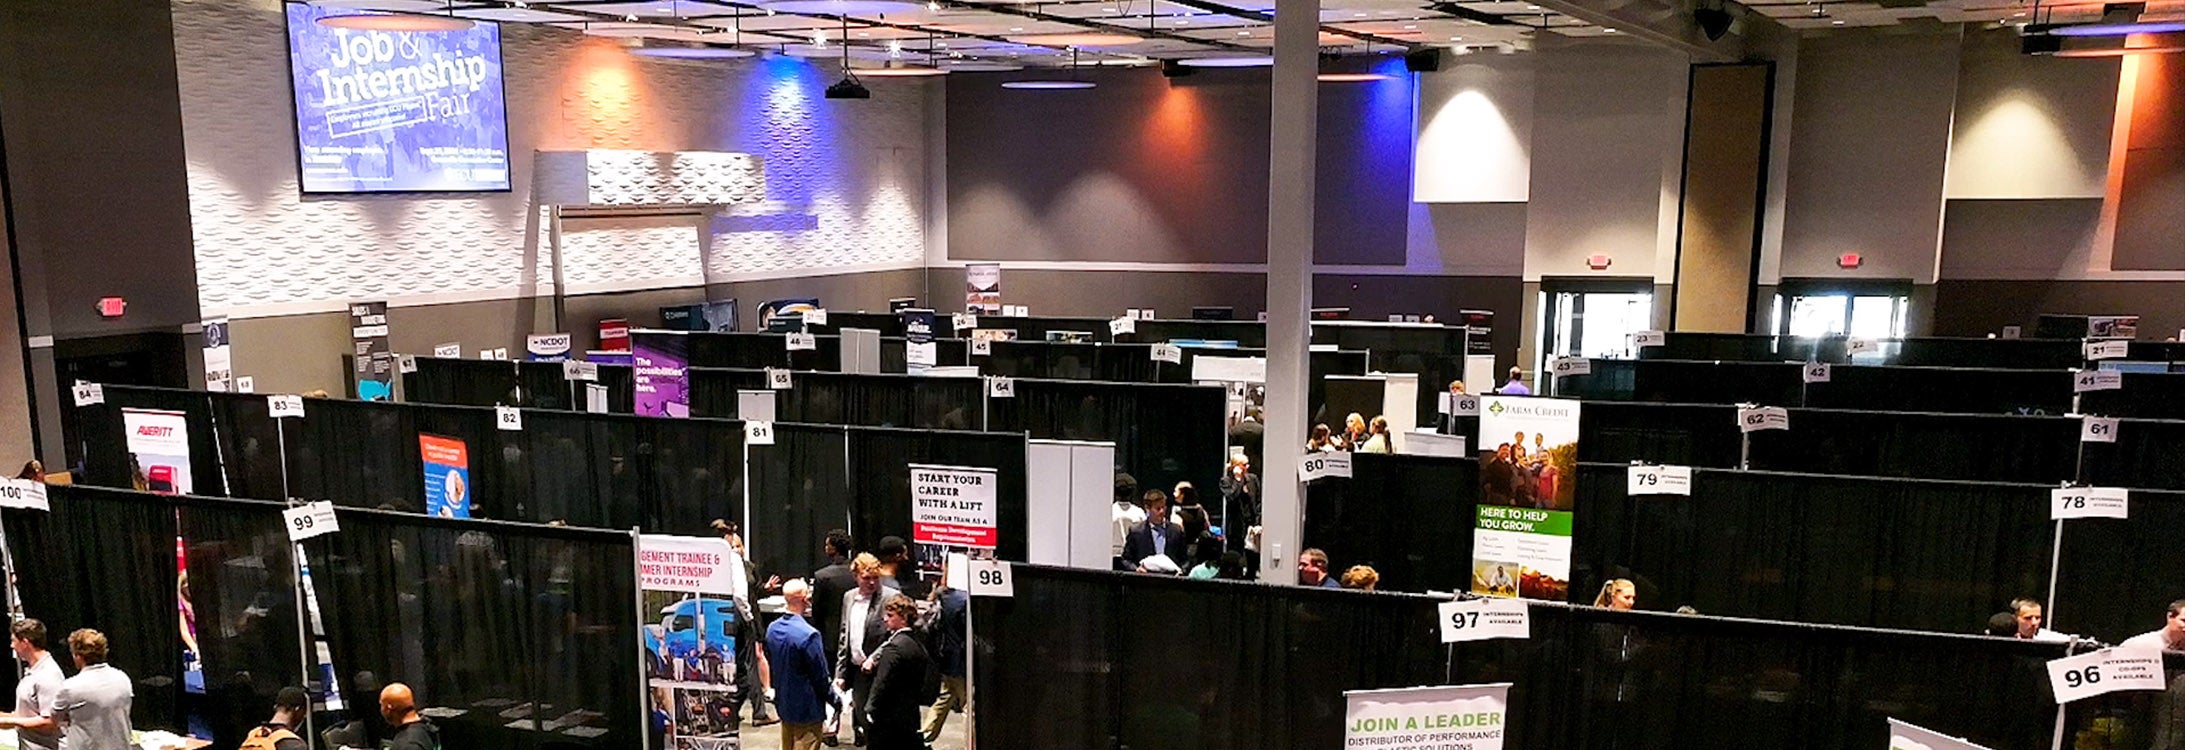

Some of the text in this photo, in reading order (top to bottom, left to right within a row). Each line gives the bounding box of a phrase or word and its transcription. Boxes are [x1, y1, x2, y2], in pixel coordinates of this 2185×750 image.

[331, 28, 422, 68] Job &
[316, 49, 486, 105] Internship
[425, 88, 470, 117] Fair
[540, 338, 568, 346] NCDOT
[636, 357, 651, 366] The
[636, 367, 682, 376] possibilities
[1810, 368, 1825, 377] 42
[996, 383, 1008, 391] 64
[2080, 377, 2094, 385] 41
[79, 390, 91, 399] 84
[274, 401, 288, 410] 83
[1460, 400, 1475, 410] 63
[503, 413, 516, 423] 82
[1747, 414, 1764, 424] 62
[137, 425, 173, 437] AVERITT
[753, 427, 767, 437] 81
[2091, 424, 2108, 434] 61
[1305, 459, 1323, 472] 80
[918, 474, 982, 485] START YOUR
[1637, 473, 1657, 485] 79
[0, 486, 21, 499] 100
[918, 486, 959, 496] CAREER
[918, 499, 983, 511] WITH A LIFT
[2061, 496, 2085, 509] 78
[1480, 507, 1548, 521] HERE TO HELP
[294, 515, 313, 530] 99
[1480, 519, 1535, 532] YOU GROW.
[677, 552, 712, 564] TRAINEE
[714, 554, 720, 565] &
[663, 565, 712, 578] INTERNSHIP
[979, 570, 1003, 585] 98
[1452, 612, 1479, 629] 97
[2065, 666, 2100, 687] 96
[1351, 712, 1500, 732] JOIN A LEADER
[1349, 730, 1500, 746] DISTRIBUTOR OF PERFORMANCE
